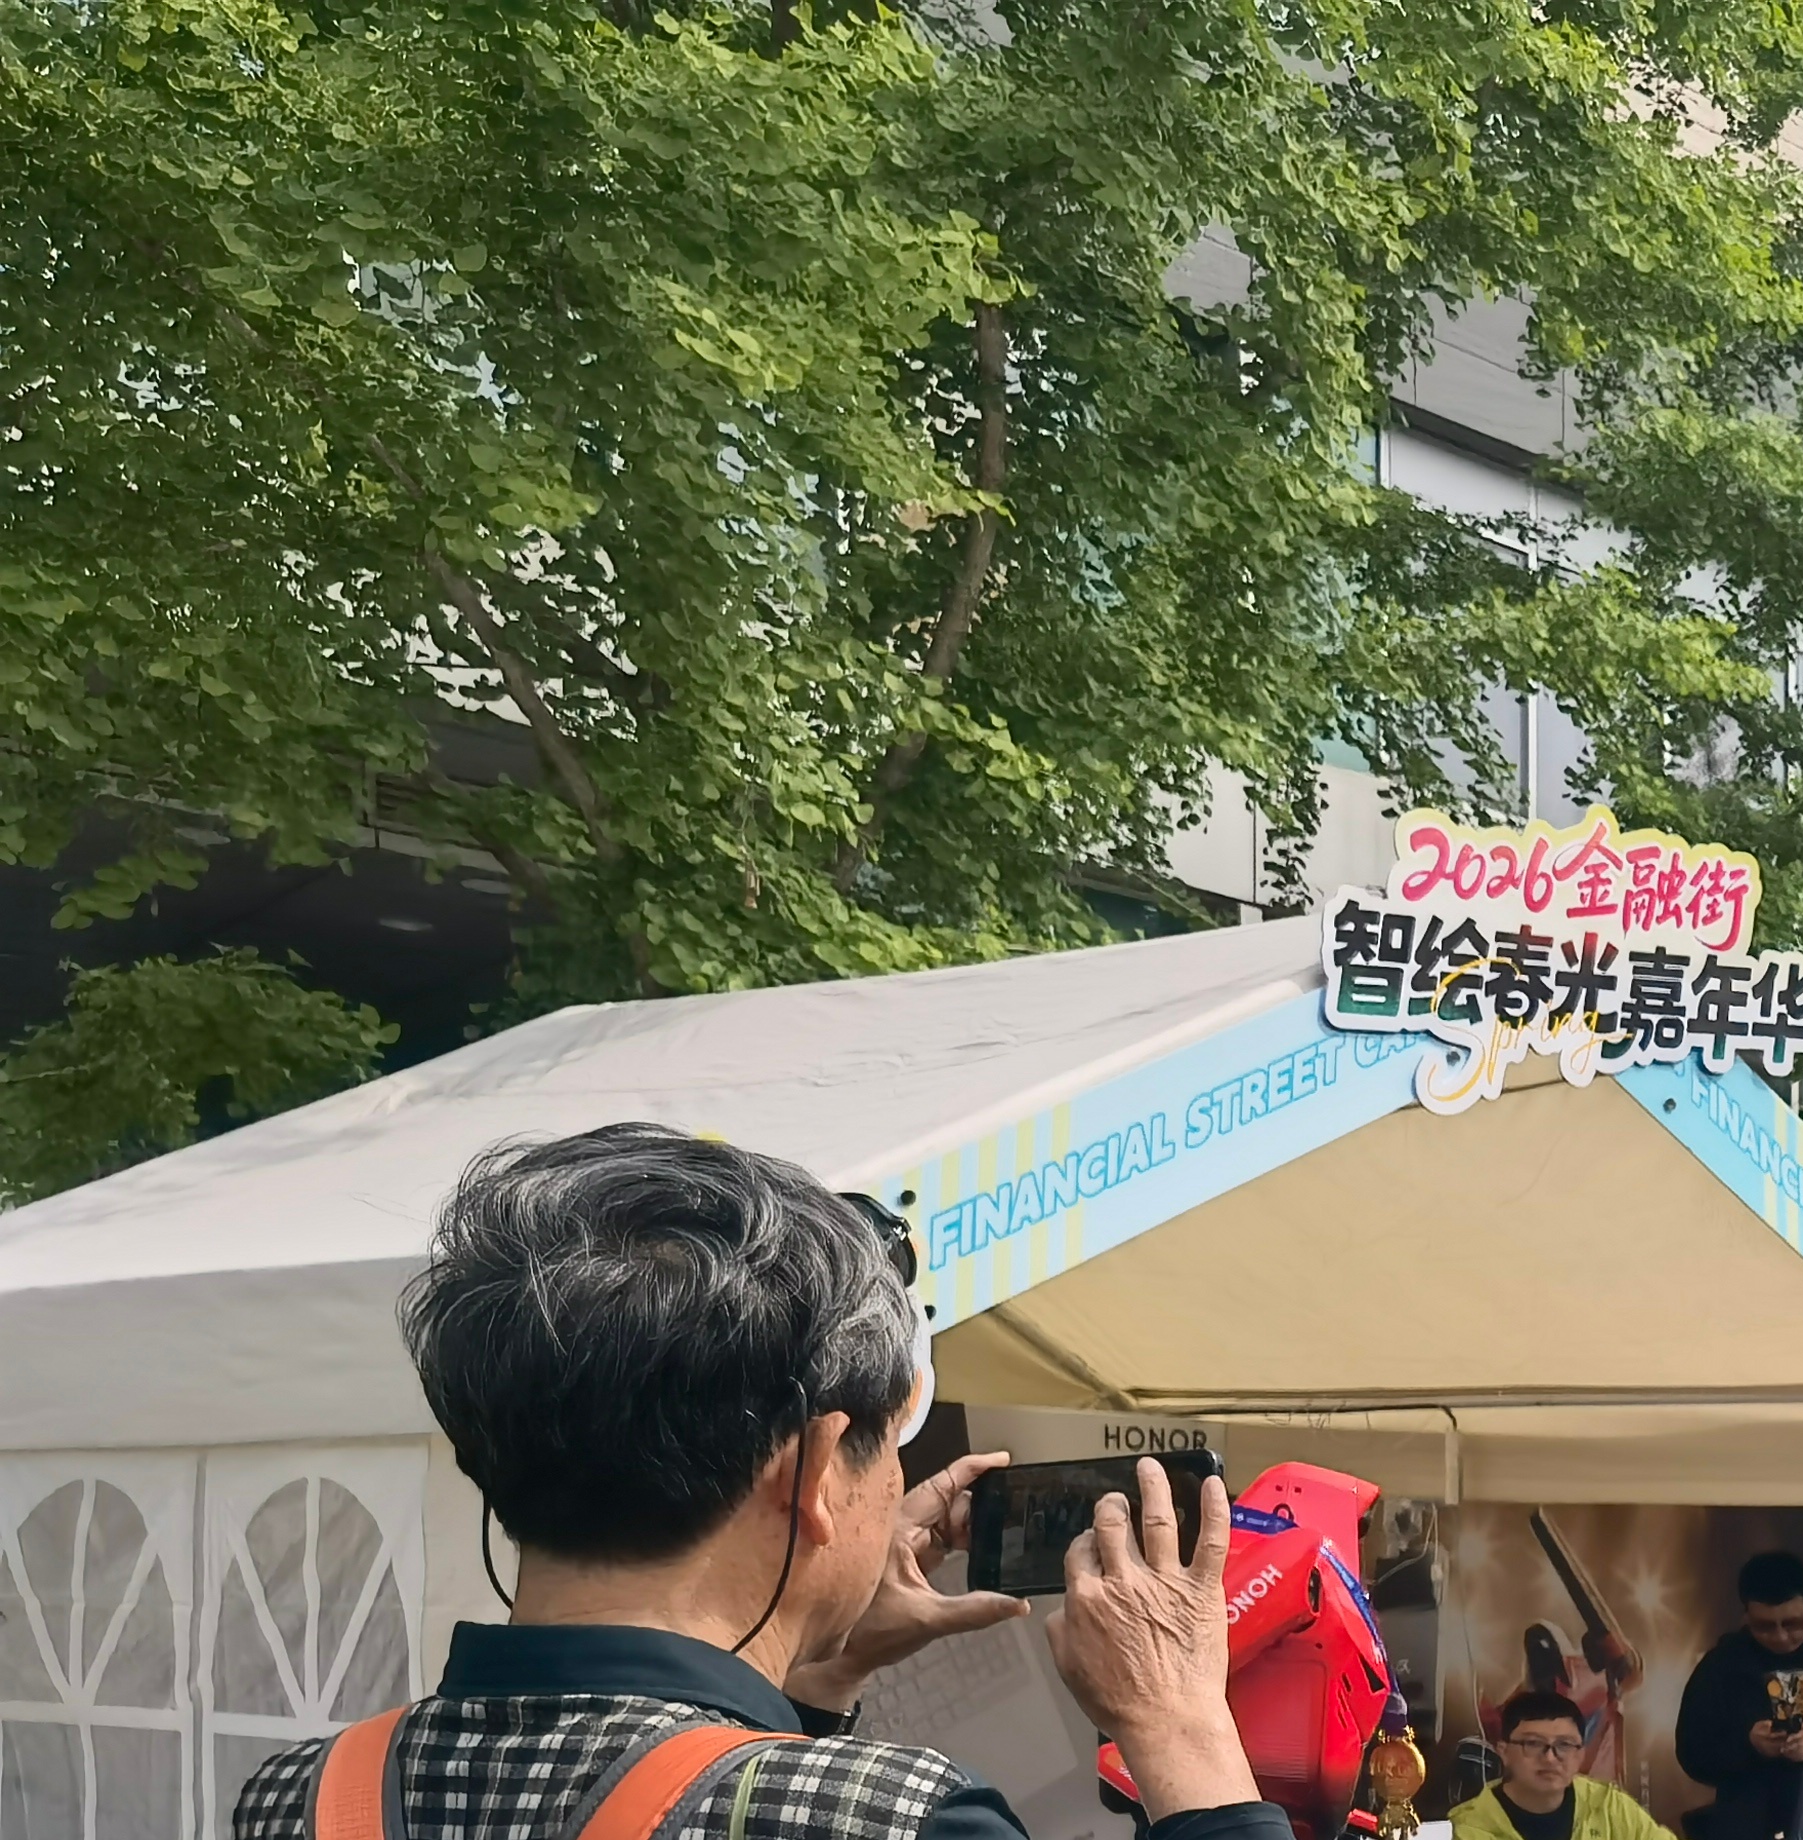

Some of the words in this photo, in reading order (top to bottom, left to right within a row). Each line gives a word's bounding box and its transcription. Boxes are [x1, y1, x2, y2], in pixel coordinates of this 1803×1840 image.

[1402, 821, 1747, 951] 2026金融街
[1424, 956, 1634, 1103] Spring
[928, 1112, 1176, 1271] FINANCIAL
[1184, 1035, 1348, 1149] STREET
[1103, 1424, 1208, 1451] HONOR
